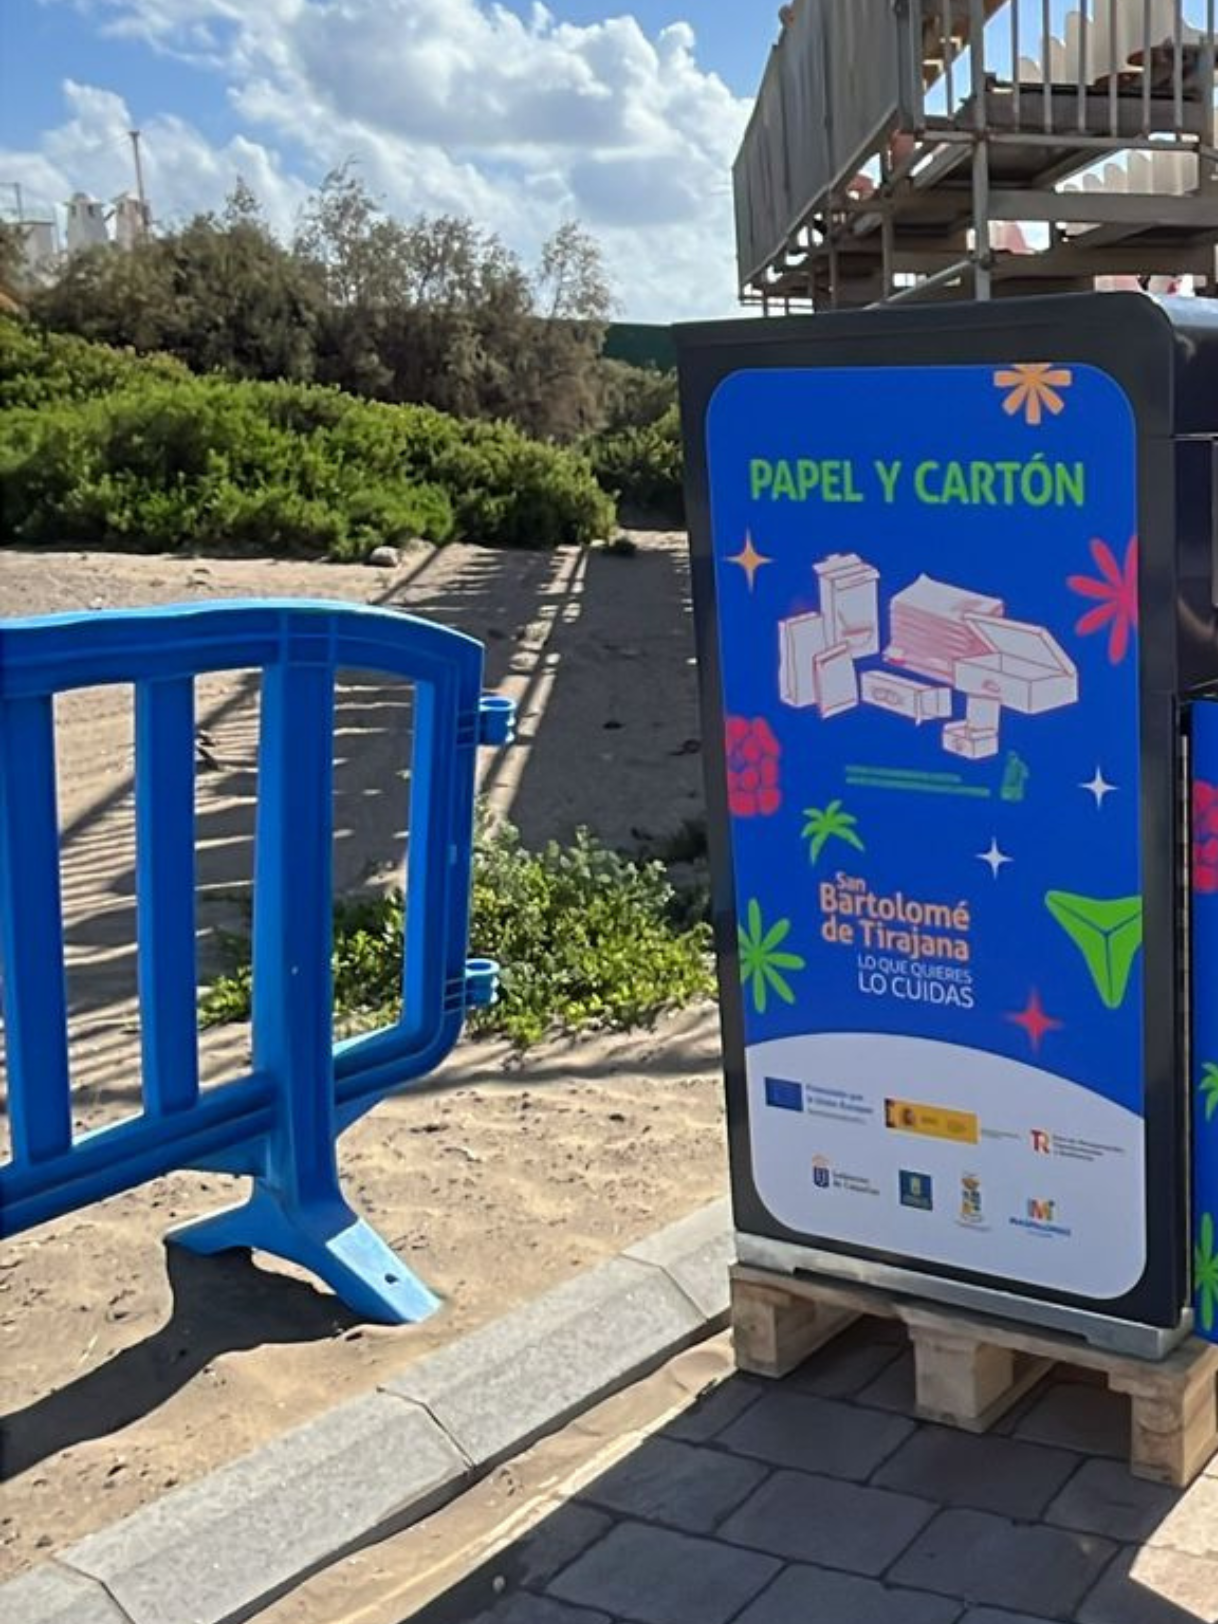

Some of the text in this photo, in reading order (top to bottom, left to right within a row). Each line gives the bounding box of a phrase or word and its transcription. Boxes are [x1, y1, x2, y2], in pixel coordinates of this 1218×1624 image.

[750, 452, 1085, 507] PAPEL Y CARTÓN
[836, 871, 866, 892] San
[820, 881, 970, 932] Bartolomé
[821, 914, 970, 963] de Tirajana
[857, 953, 973, 985] LO QUE QUIERES
[858, 971, 975, 1010] LO CUIDAS
